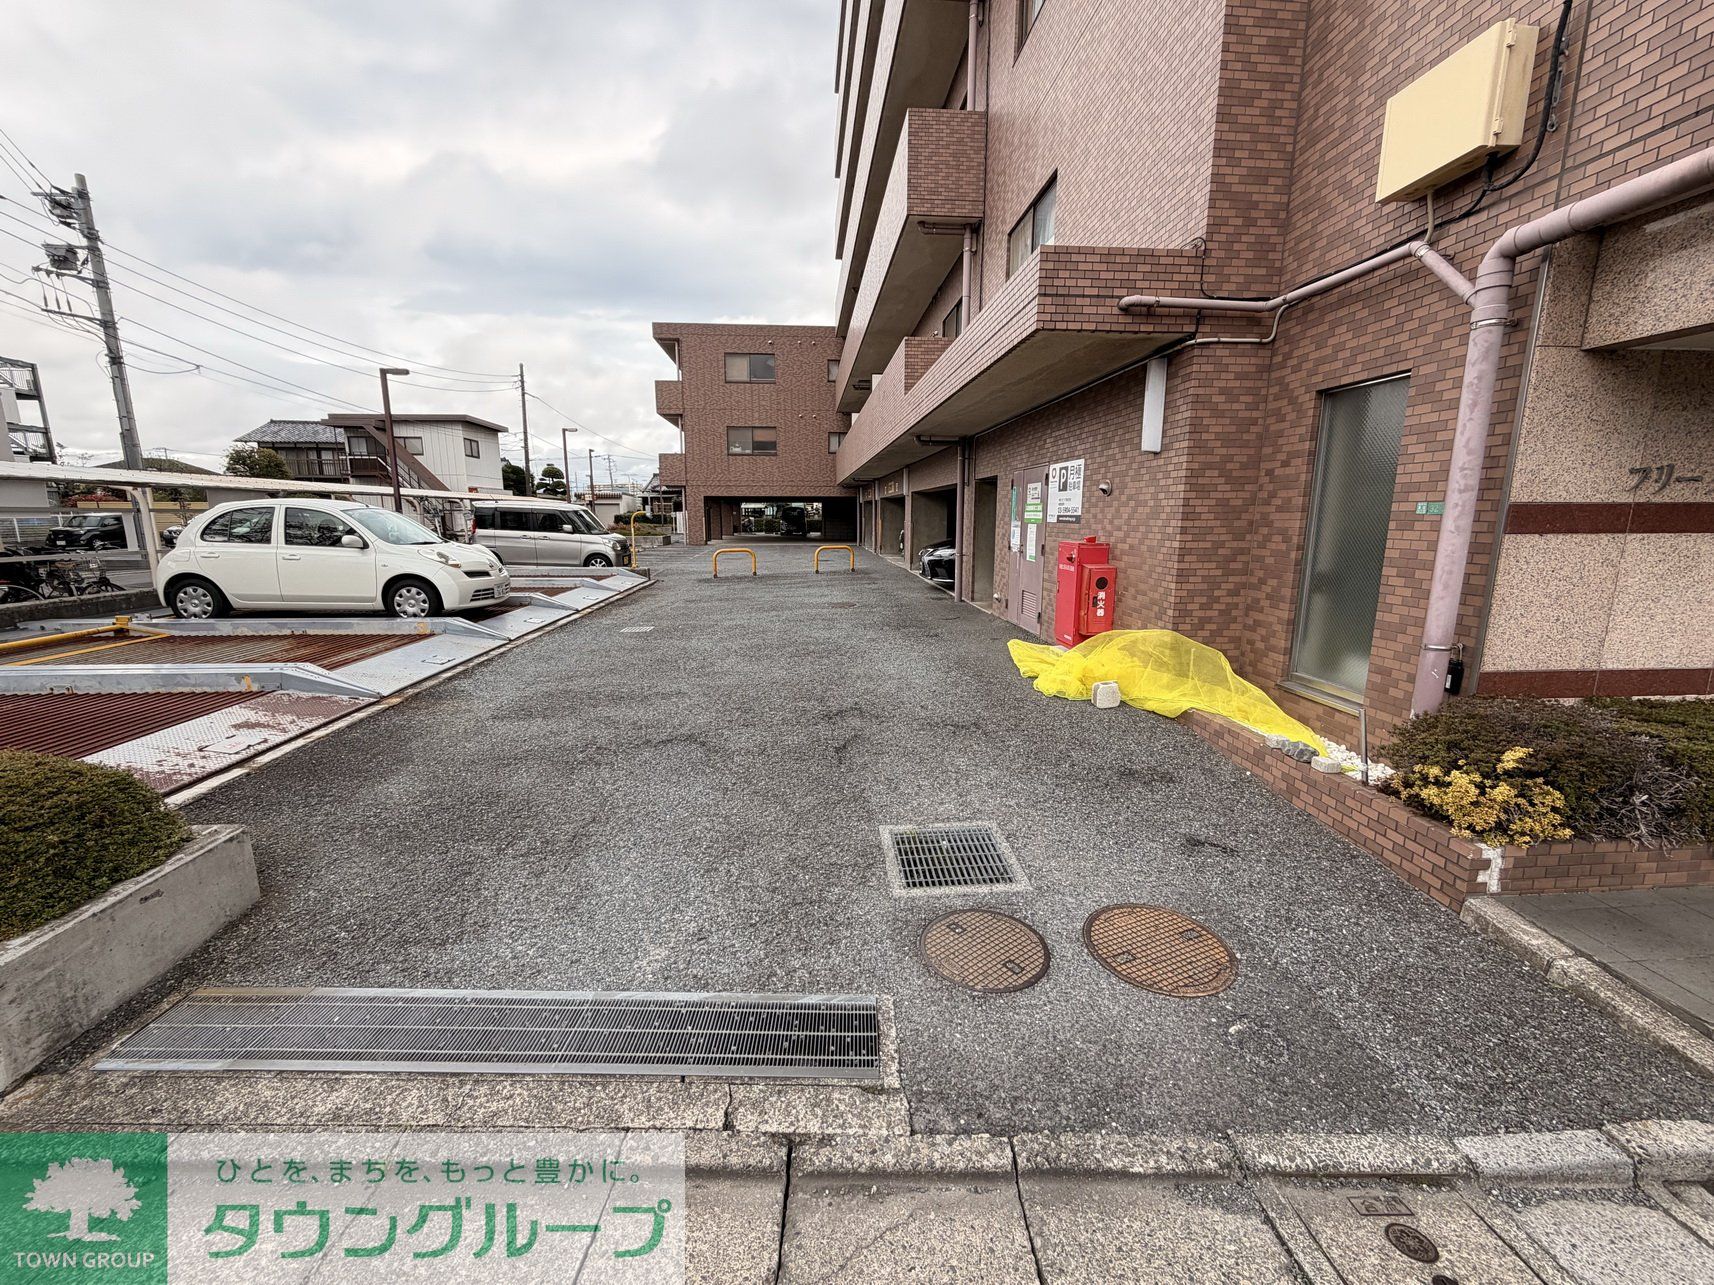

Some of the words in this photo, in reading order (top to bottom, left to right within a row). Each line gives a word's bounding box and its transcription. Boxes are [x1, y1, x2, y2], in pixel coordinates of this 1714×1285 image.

[1069, 464, 1082, 480] 月極
[1624, 463, 1704, 495] フリー
[1096, 591, 1106, 617] 消火器
